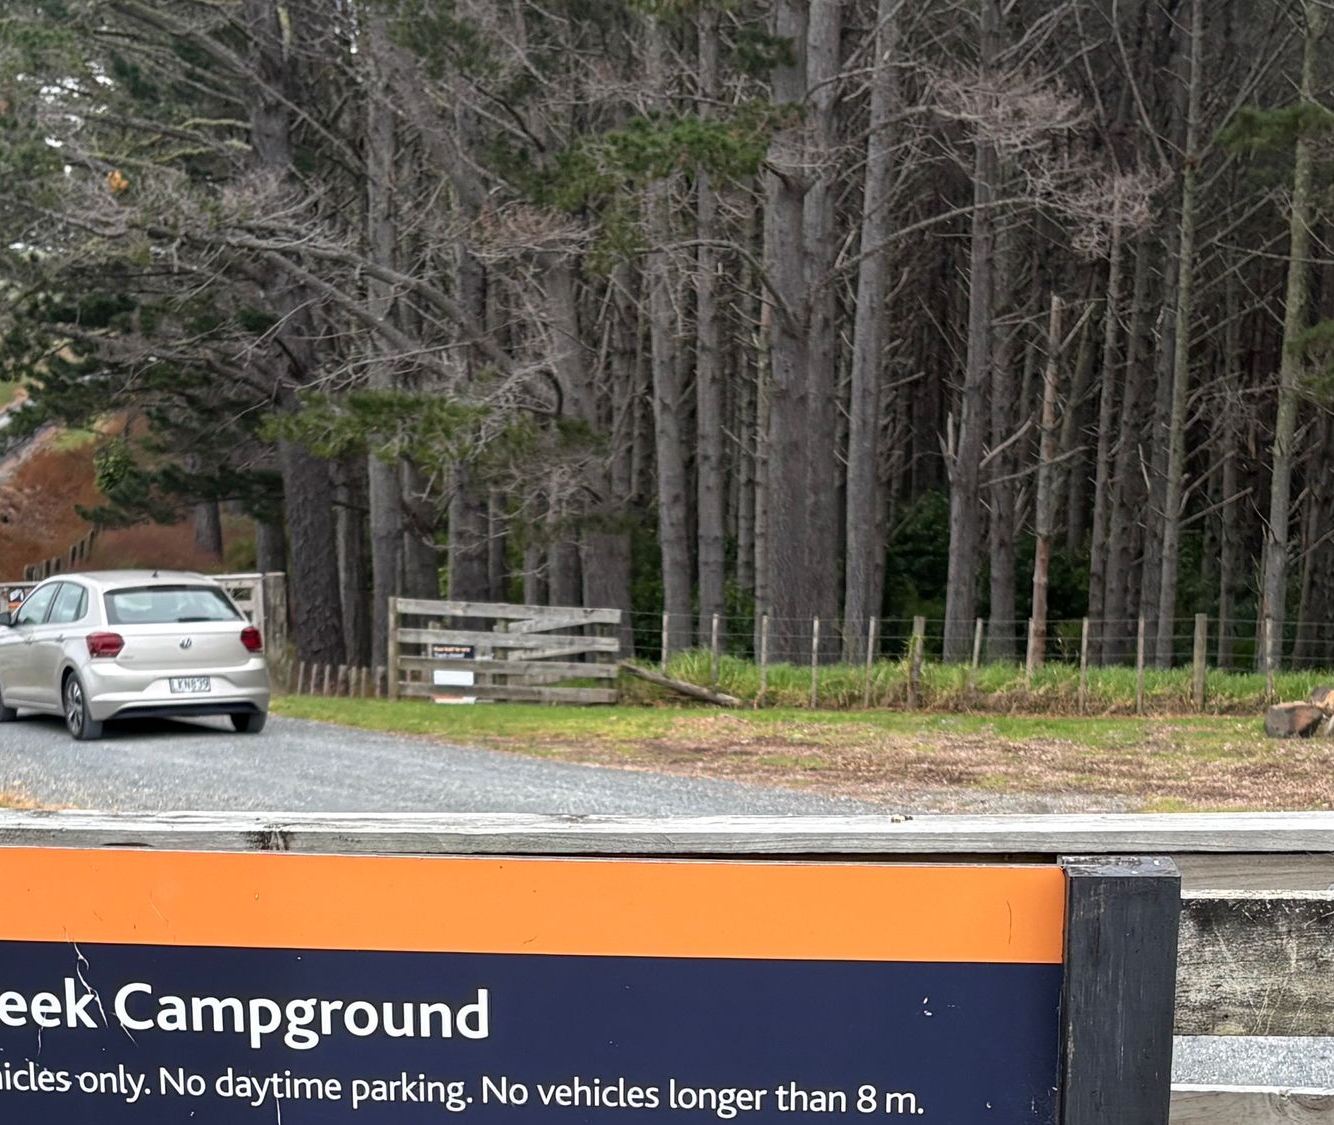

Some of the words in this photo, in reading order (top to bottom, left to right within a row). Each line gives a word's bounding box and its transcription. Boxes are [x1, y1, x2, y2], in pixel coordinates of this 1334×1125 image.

[114, 983, 488, 1049] Campground
[79, 1067, 151, 1103] only.
[159, 1067, 206, 1097] No
[216, 1073, 342, 1106] daytime
[352, 1073, 473, 1111] parking.
[482, 1076, 528, 1106] No
[537, 1077, 659, 1108] vehicles
[669, 1078, 767, 1119] longer
[775, 1081, 846, 1112] than
[857, 1085, 877, 1113] 8
[885, 1089, 924, 1114] m.
